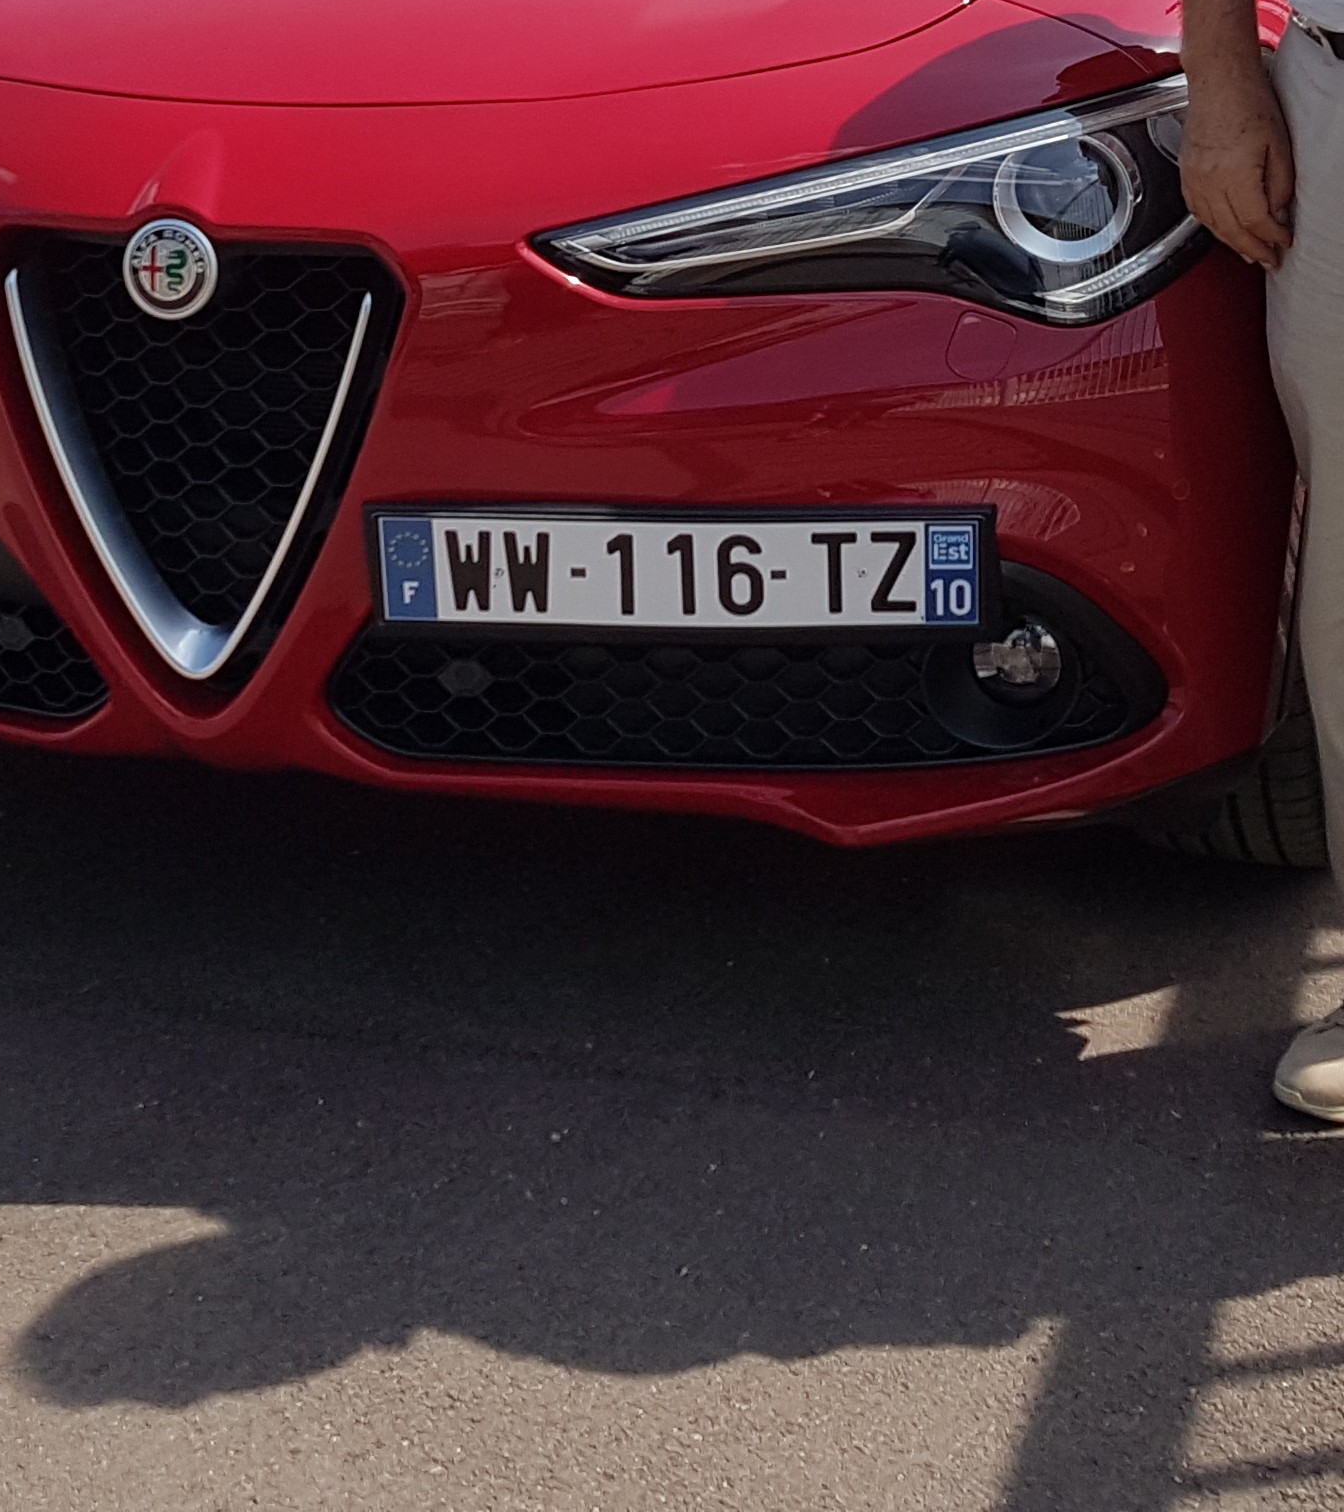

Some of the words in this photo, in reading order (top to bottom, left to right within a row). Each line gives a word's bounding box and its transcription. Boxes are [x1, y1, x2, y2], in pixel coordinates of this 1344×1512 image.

[933, 533, 969, 543] Grand
[933, 543, 969, 560] Est
[403, 582, 418, 605] F
[930, 579, 972, 616] 10
